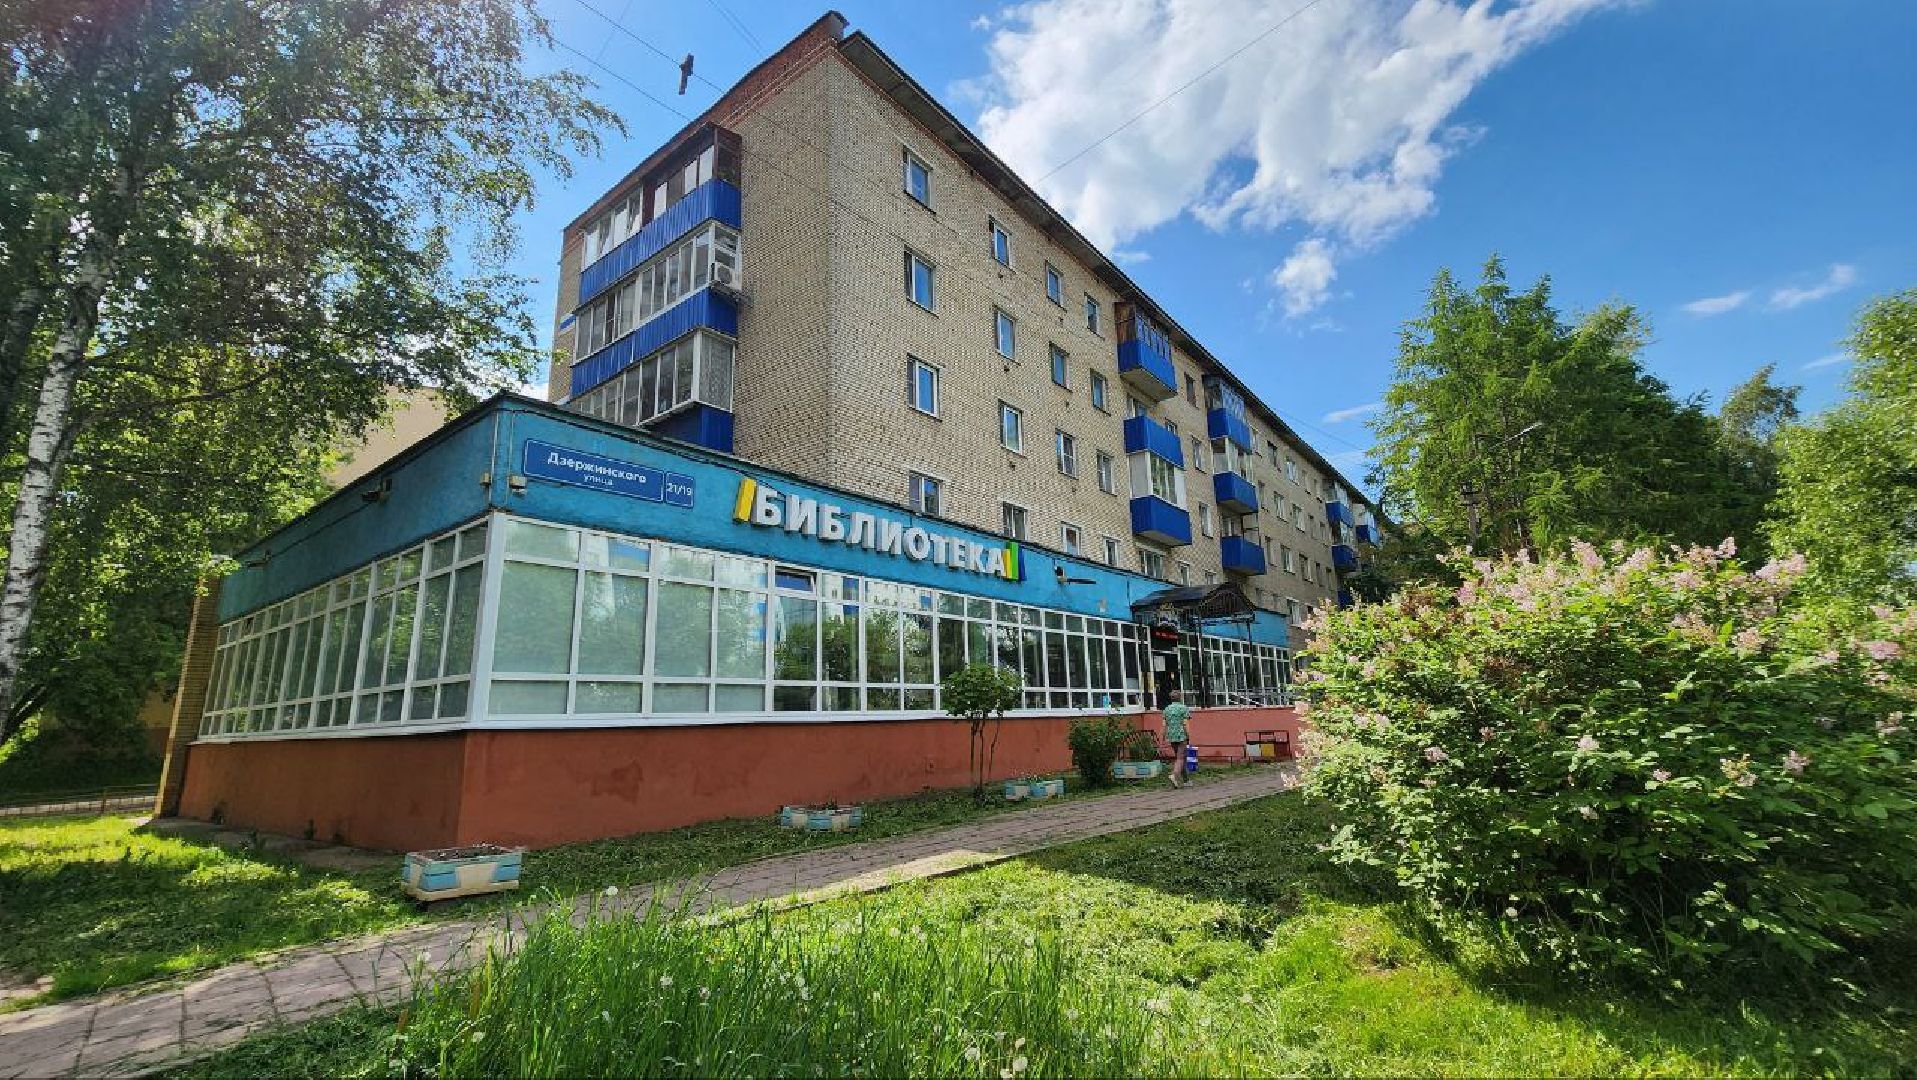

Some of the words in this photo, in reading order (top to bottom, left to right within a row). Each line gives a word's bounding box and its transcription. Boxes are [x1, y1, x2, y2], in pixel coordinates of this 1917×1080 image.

[547, 452, 647, 483] Дзержинского
[584, 474, 613, 485] улица
[666, 482, 692, 496] 21/19
[751, 485, 1007, 575] БИБЛИОТЕКА
